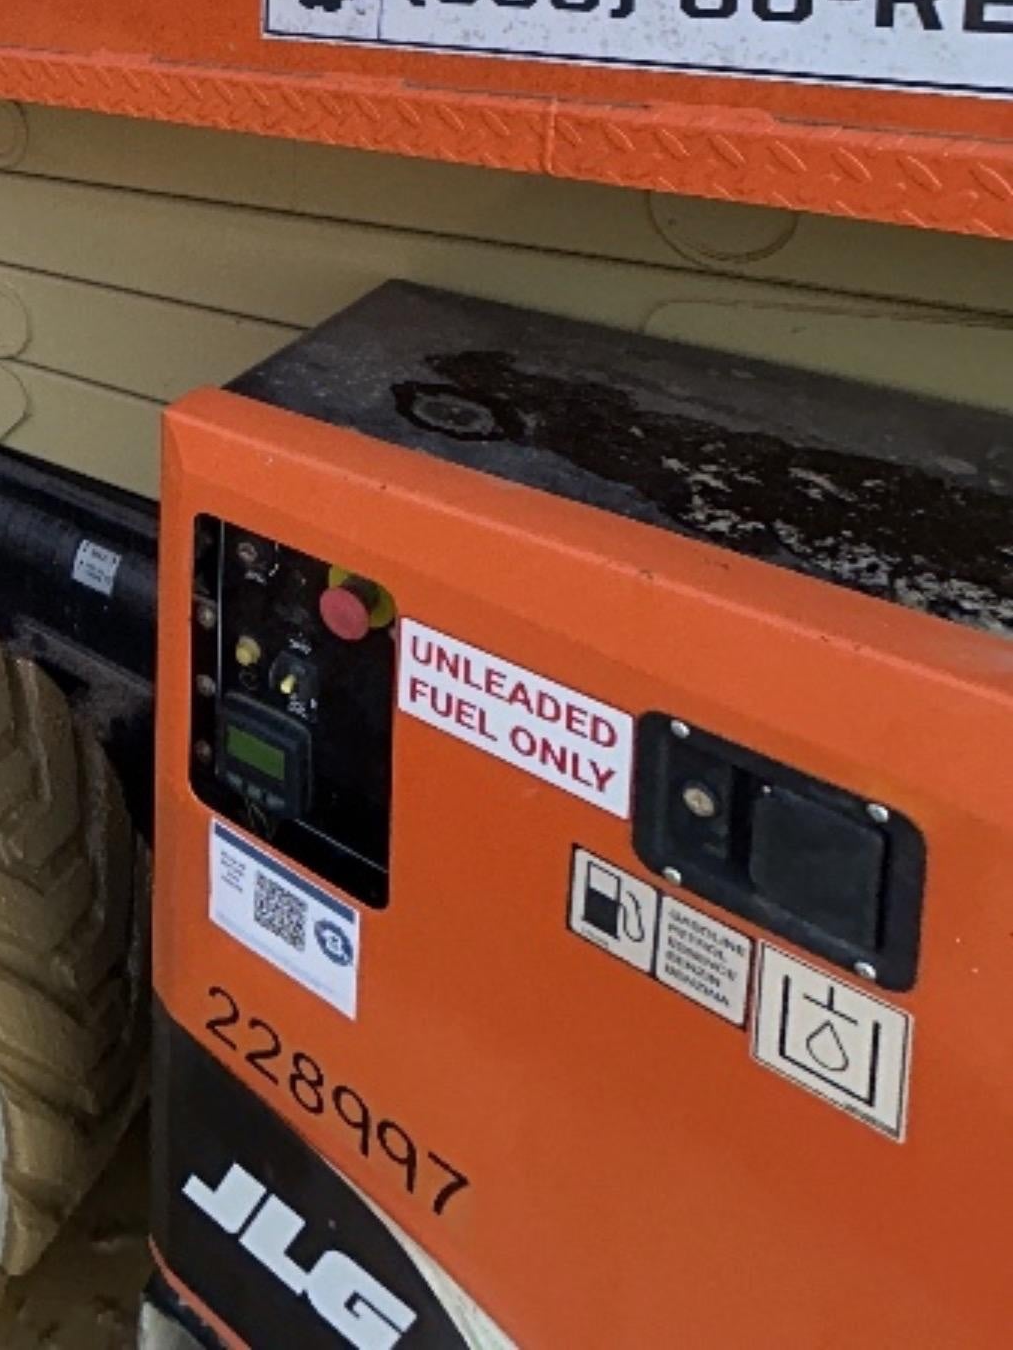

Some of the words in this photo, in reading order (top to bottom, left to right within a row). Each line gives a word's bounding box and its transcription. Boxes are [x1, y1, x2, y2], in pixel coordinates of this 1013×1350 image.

[409, 676, 498, 742] FUEL
[509, 725, 616, 793] ONLY
[411, 635, 618, 748] UNLEADED
[204, 985, 470, 1216] 228997
[181, 1161, 418, 1350] JLG
